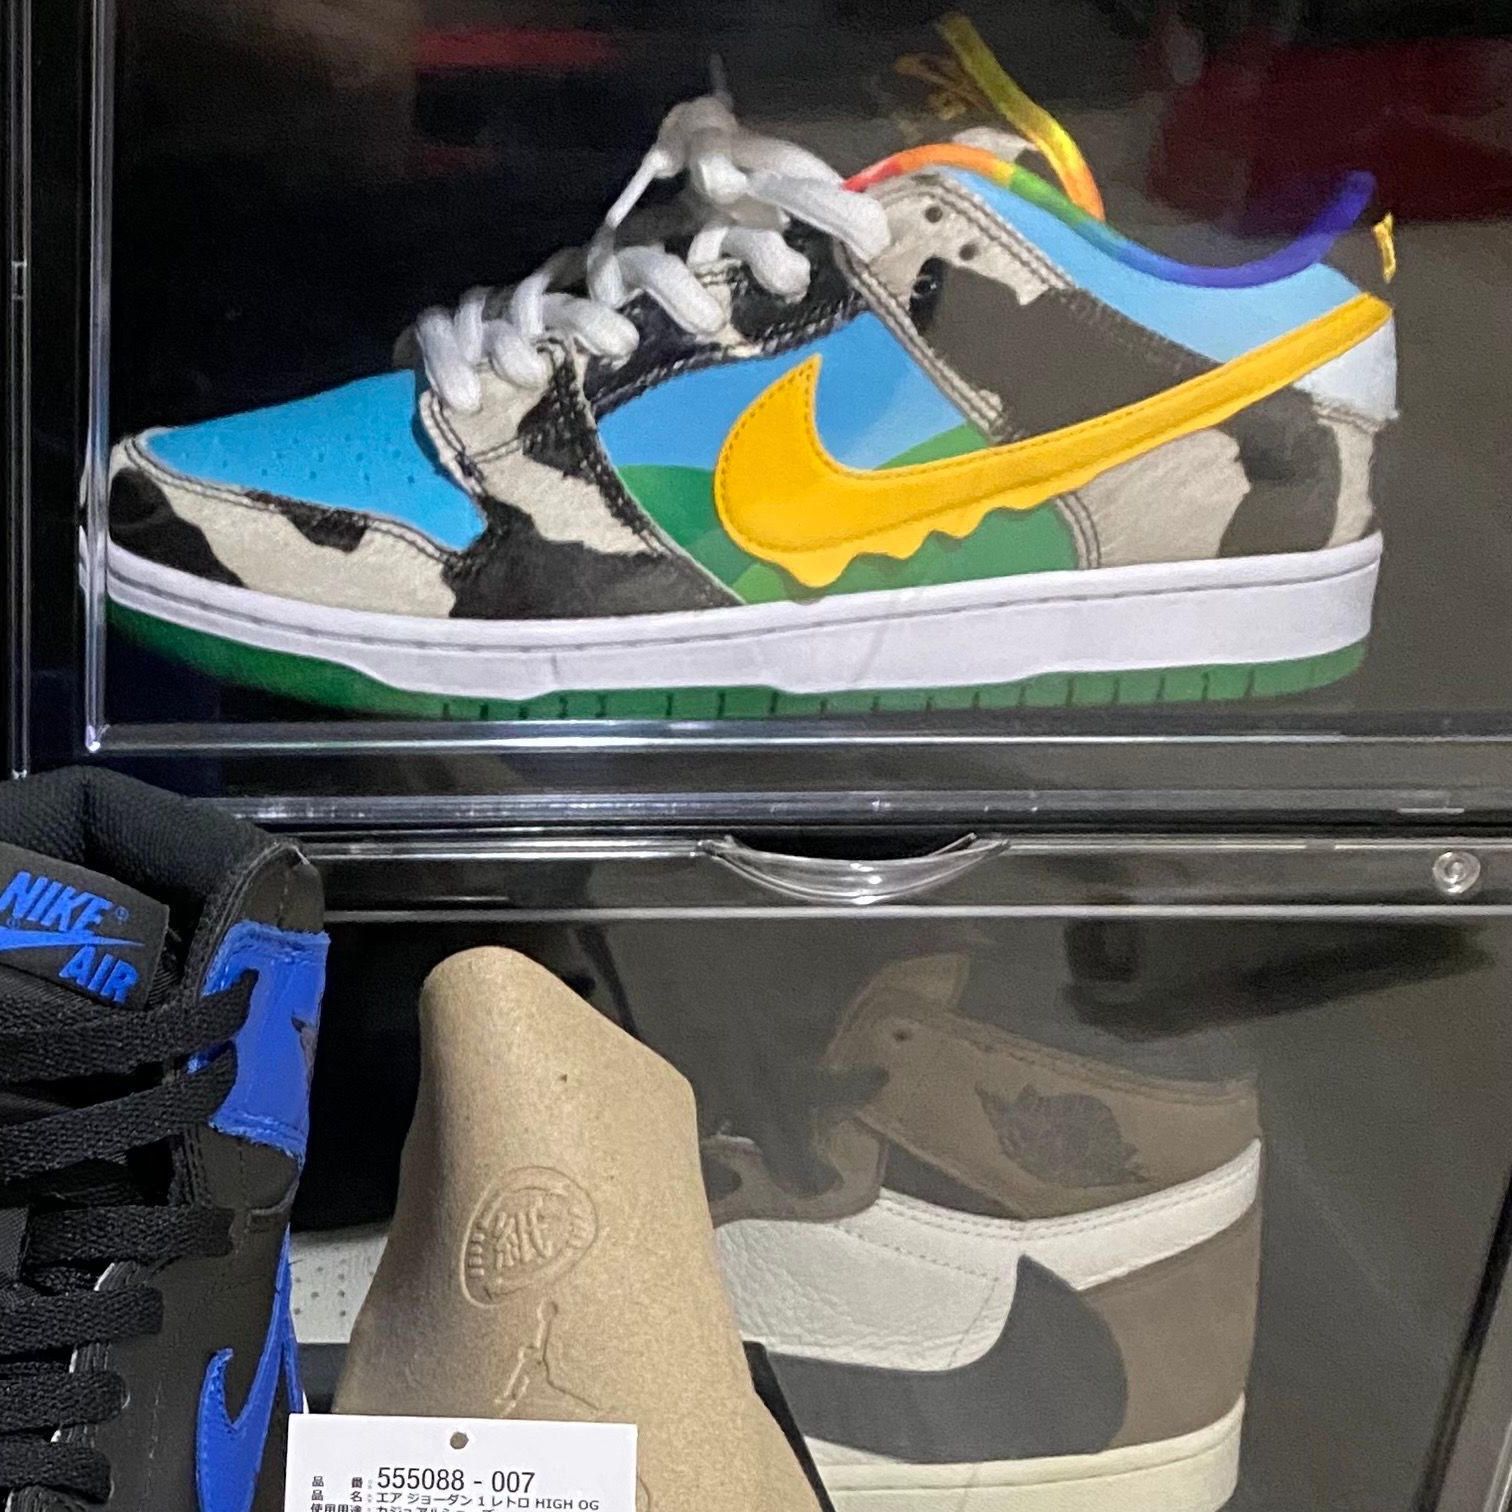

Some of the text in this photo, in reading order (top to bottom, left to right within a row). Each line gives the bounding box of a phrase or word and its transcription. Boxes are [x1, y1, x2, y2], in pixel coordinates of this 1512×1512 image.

[58, 945, 138, 1003] AIR
[377, 1467, 465, 1491] 555088
[491, 1470, 535, 1493] 007
[535, 1498, 573, 1510] HIGH
[578, 1500, 600, 1511] OG
